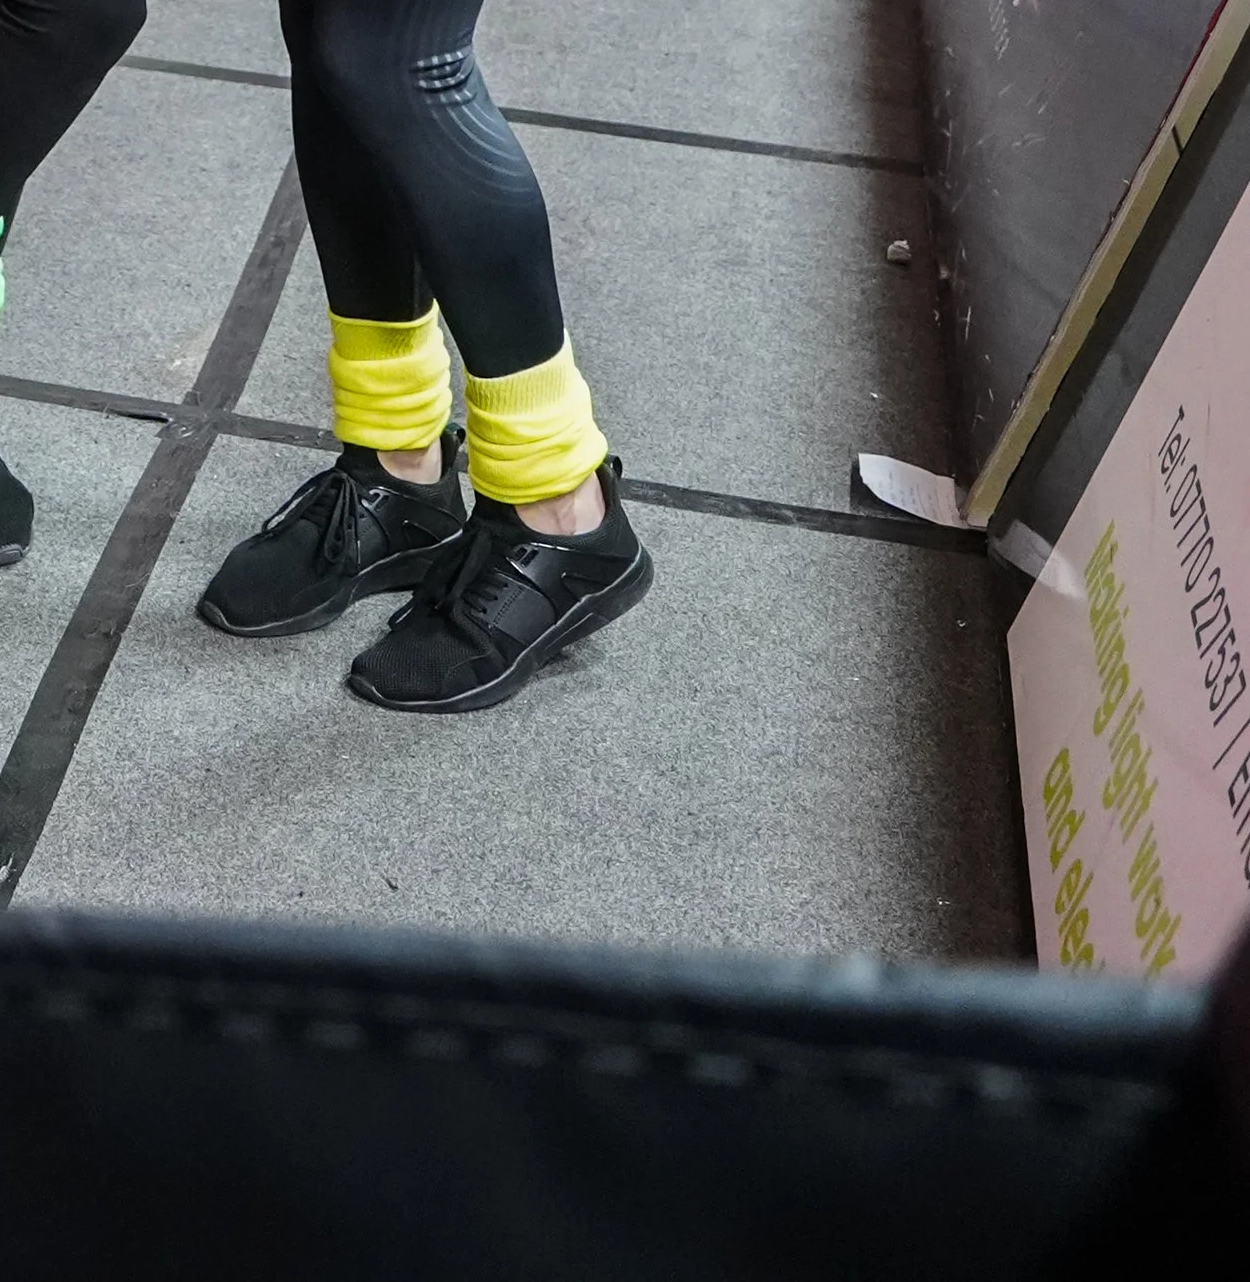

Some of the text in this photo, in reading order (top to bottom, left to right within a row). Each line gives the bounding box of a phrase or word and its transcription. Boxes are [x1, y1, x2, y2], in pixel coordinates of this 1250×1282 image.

[1158, 404, 1191, 493] Tel:
[1170, 464, 1215, 593] 07770
[1190, 567, 1247, 728] 227537
[1043, 747, 1085, 874] and
[1084, 518, 1181, 976] Making light work
